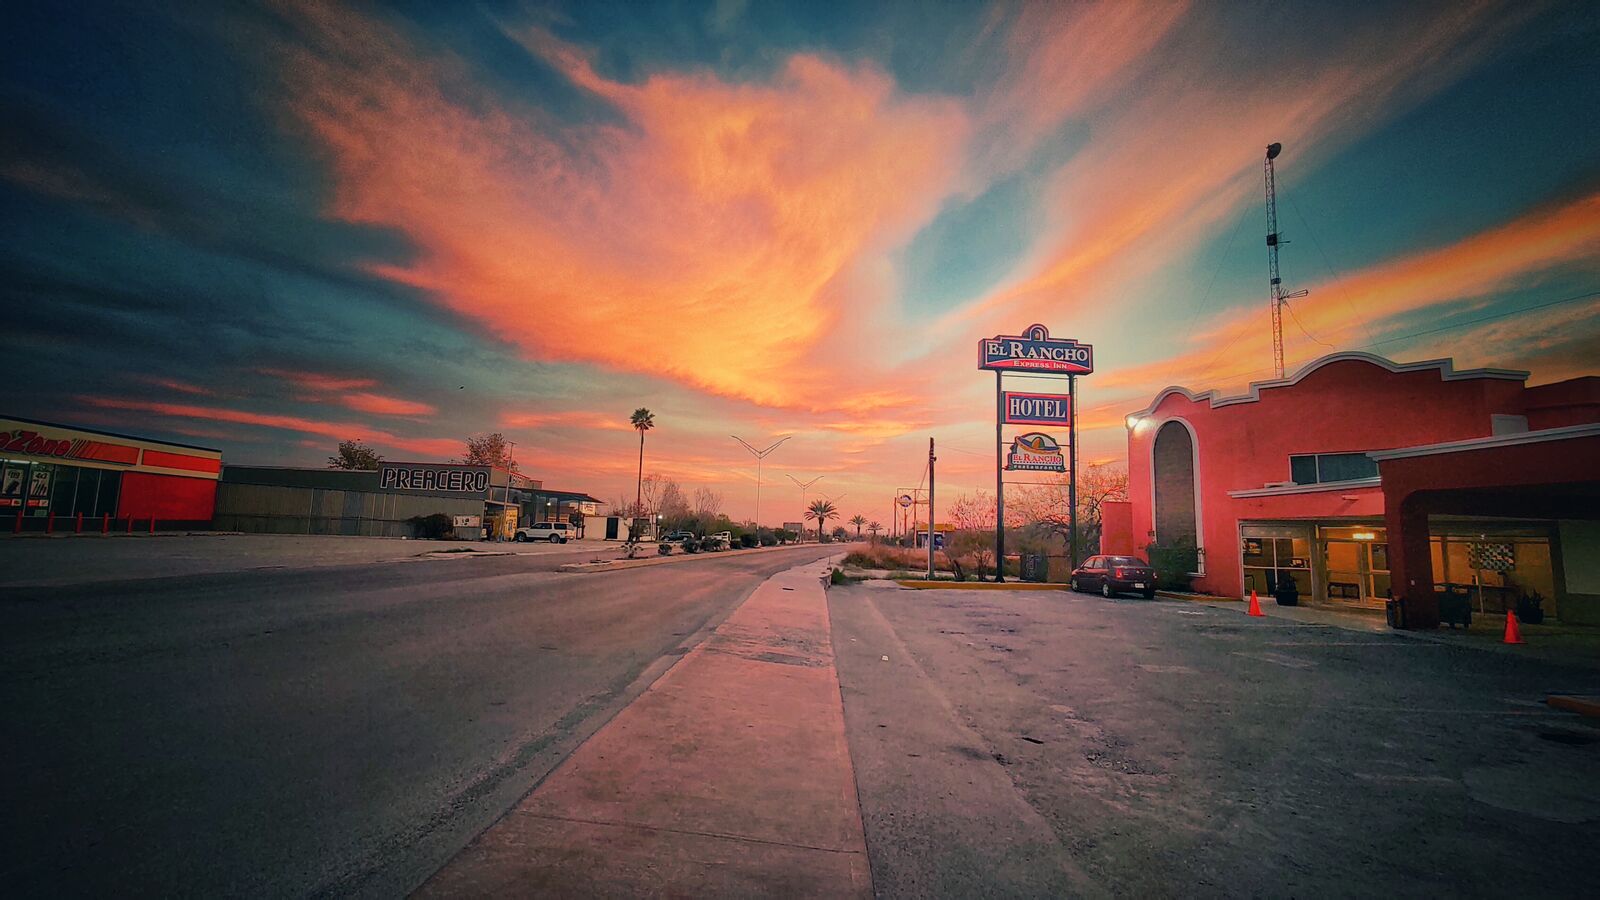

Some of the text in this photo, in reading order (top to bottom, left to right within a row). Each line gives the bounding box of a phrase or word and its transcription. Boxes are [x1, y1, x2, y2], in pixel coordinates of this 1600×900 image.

[988, 341, 1088, 361] EL RANCHO
[1013, 361, 1050, 369] EXPRESS
[1010, 398, 1066, 418] HOTEL
[1024, 453, 1061, 462] RANCHO
[380, 468, 489, 492] PREACERO
